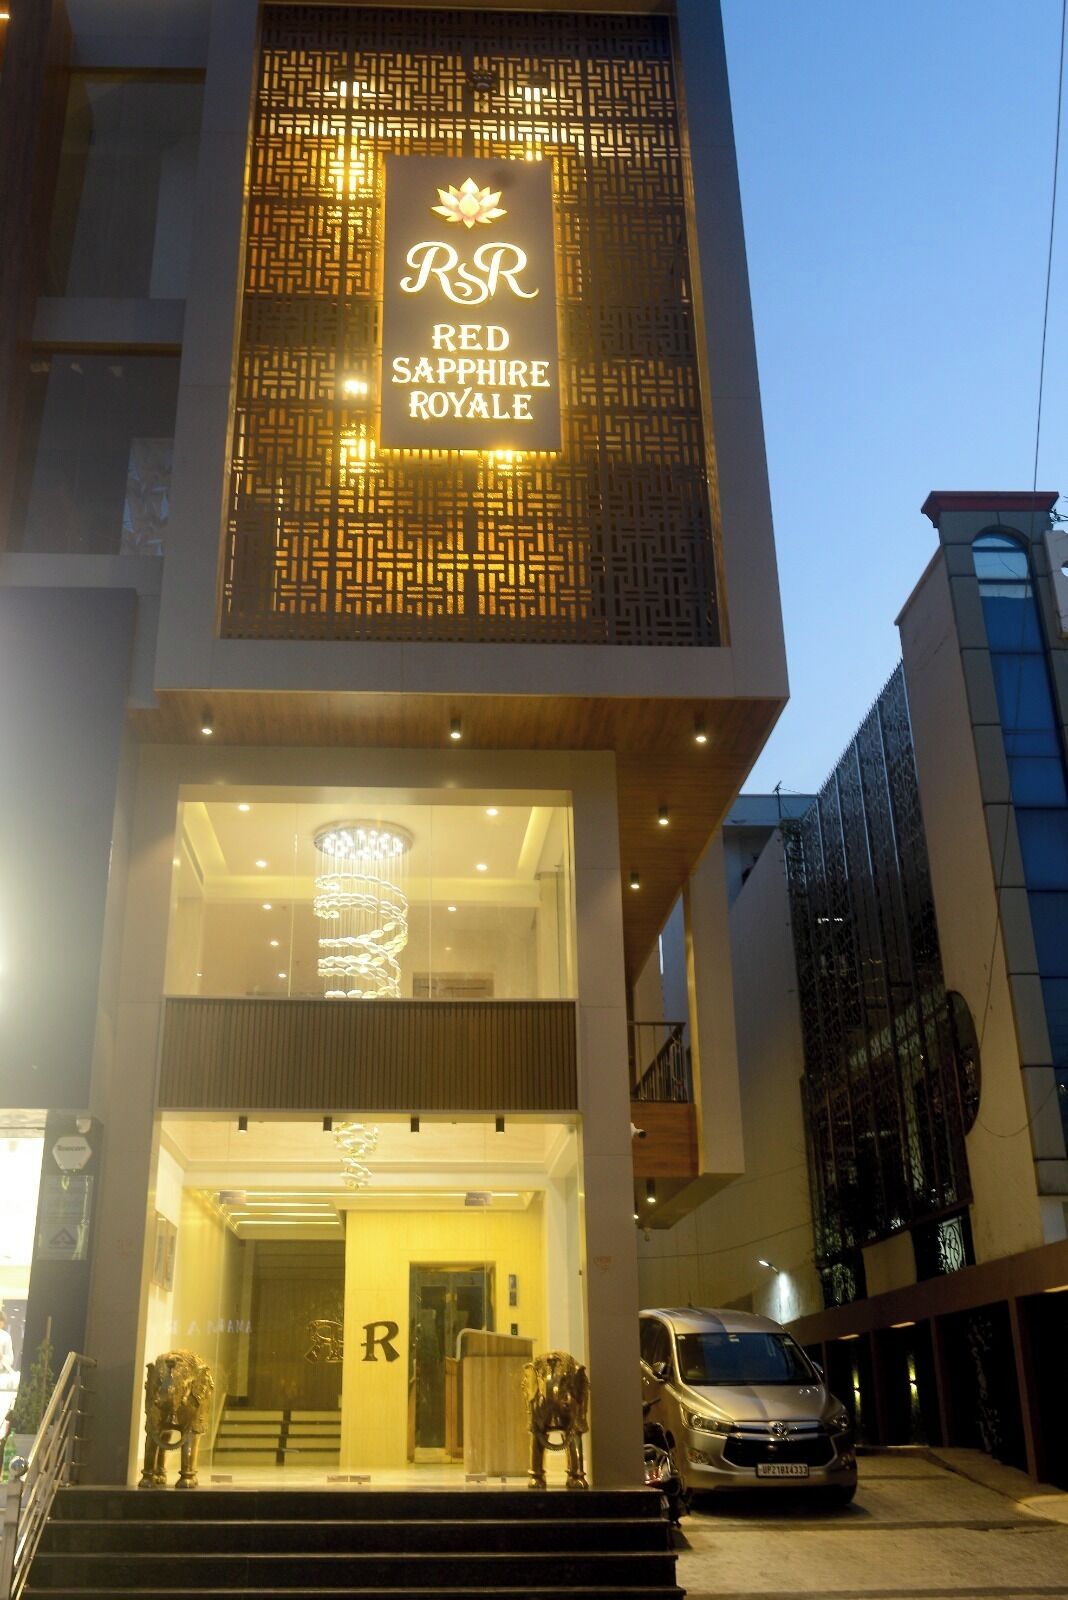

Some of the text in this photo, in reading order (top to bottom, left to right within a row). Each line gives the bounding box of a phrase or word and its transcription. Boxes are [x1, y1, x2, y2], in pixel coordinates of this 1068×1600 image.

[432, 324, 510, 352] RED
[392, 357, 551, 388] SAPPHIRE
[409, 387, 534, 421] ROYALE
[361, 1320, 401, 1363] R
